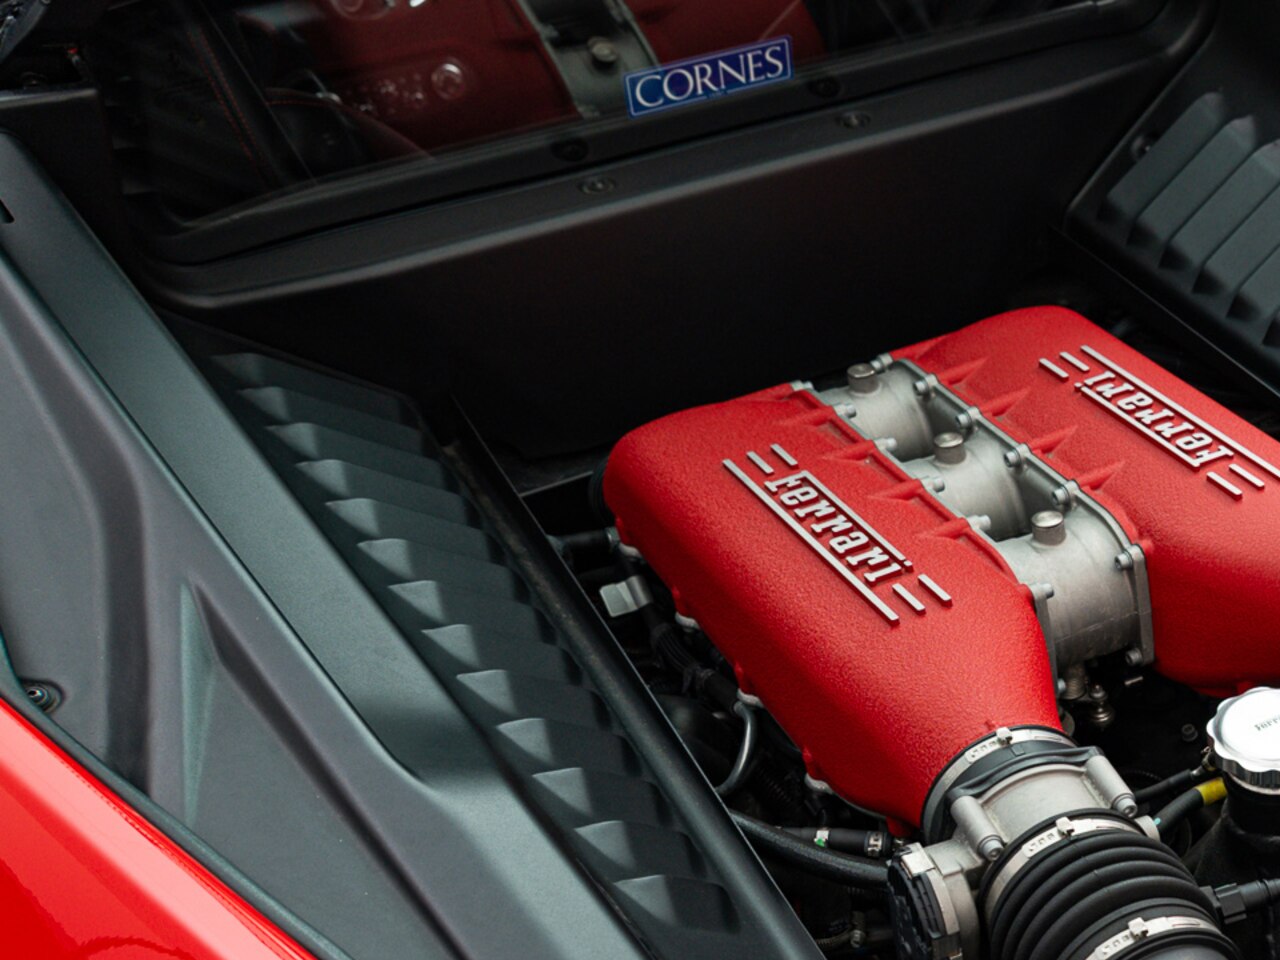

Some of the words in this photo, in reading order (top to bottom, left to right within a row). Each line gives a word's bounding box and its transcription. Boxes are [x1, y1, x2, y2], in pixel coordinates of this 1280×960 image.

[635, 46, 784, 108] CORNES
[1074, 370, 1235, 468] Ferrari
[764, 469, 913, 583] Ferrari
